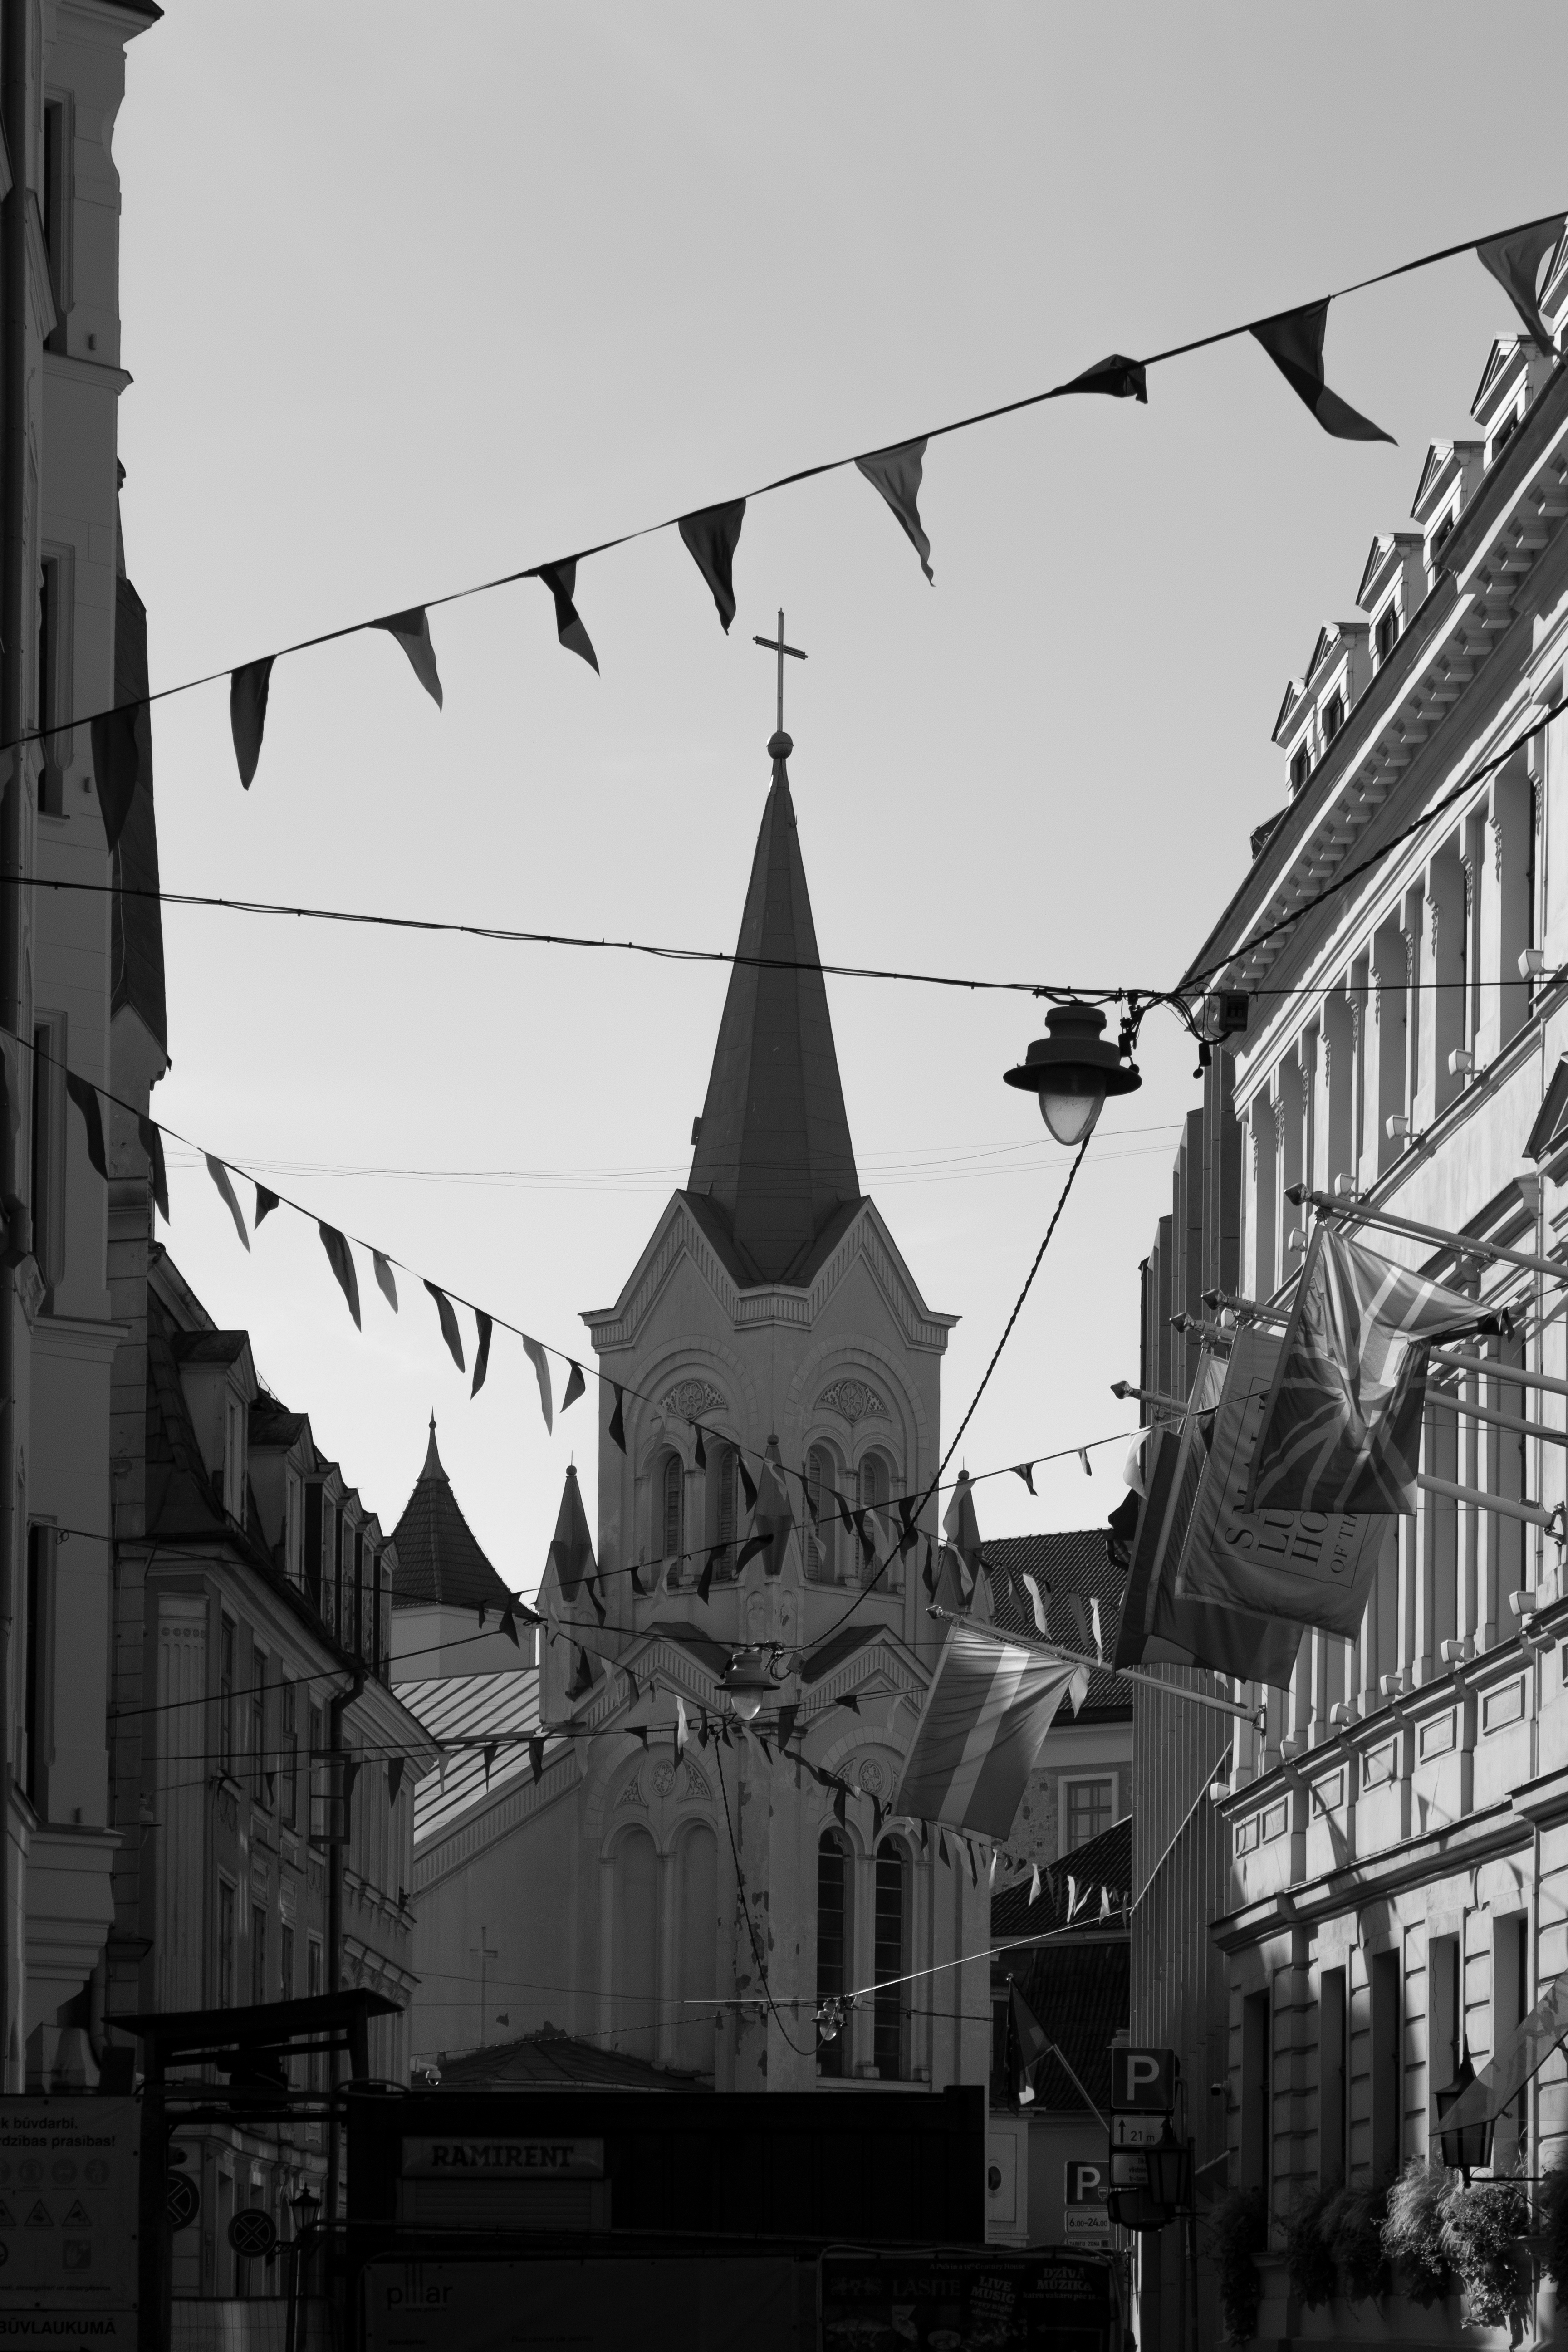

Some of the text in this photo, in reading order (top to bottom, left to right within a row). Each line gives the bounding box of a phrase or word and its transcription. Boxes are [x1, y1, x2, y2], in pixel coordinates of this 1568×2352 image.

[1331, 1544, 1348, 1573] OF
[1127, 2055, 1159, 2101] P
[14, 2117, 78, 2129] būvdarbi.
[52, 2135, 115, 2149] prasības!
[1131, 2130, 1142, 2141] 21
[431, 2145, 574, 2167] RAMIRENT
[1077, 2167, 1101, 2200] P
[1043, 2266, 1086, 2279] DZĪVĀ
[979, 2276, 1012, 2292] LIVE
[1036, 2278, 1093, 2291] MŪZIKA
[970, 2286, 1016, 2304] MUSIC
[969, 2299, 1013, 2313] every night
[971, 2308, 990, 2317] after
